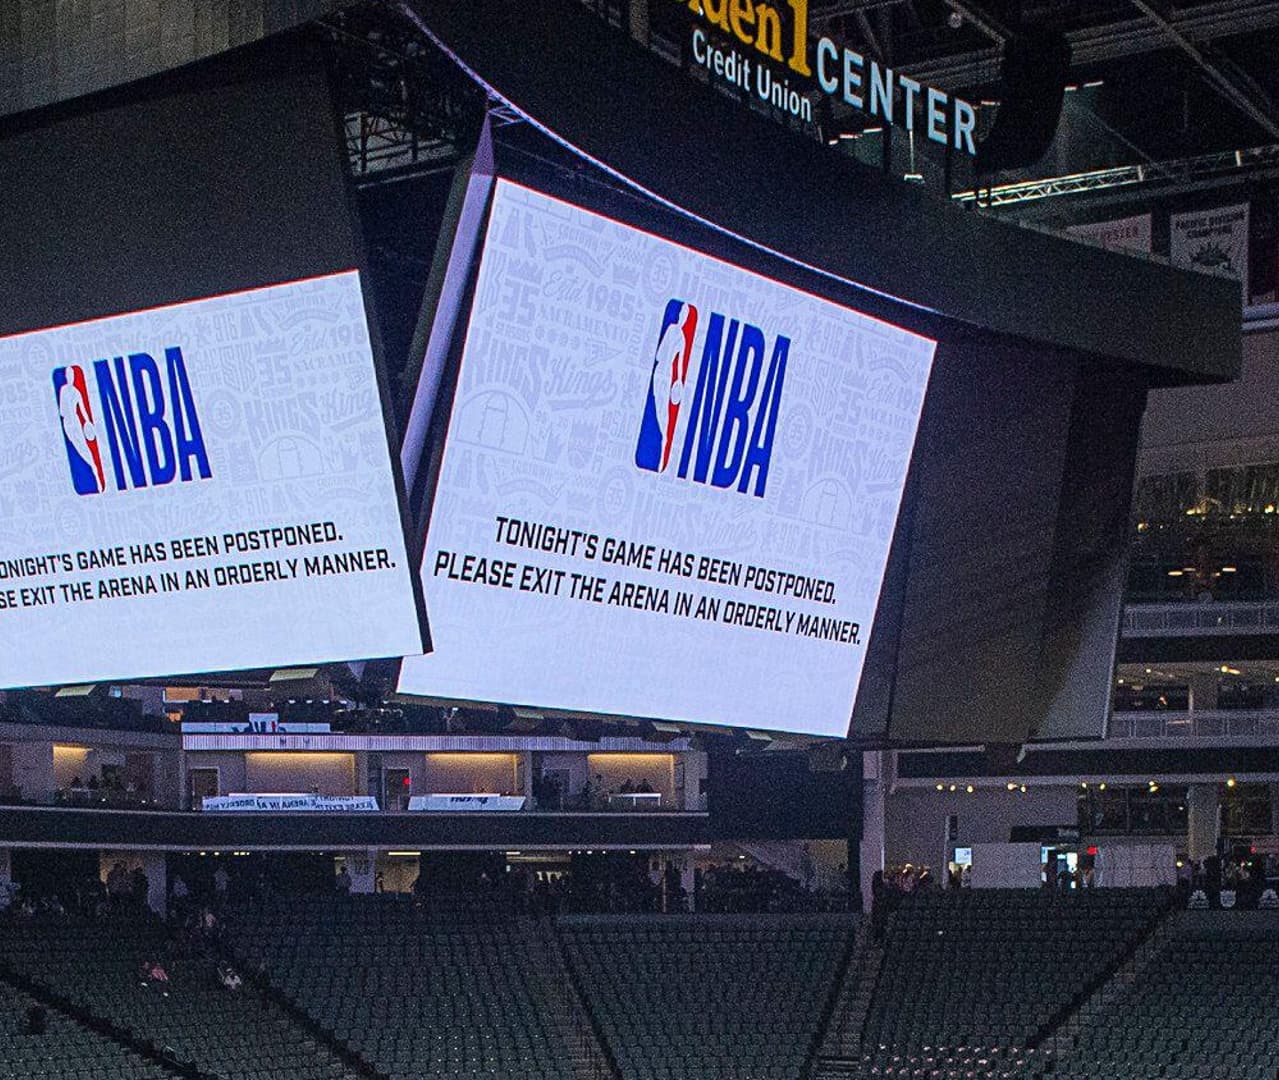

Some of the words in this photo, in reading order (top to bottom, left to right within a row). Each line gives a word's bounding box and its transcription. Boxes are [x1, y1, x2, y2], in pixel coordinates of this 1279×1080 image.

[687, 0, 812, 77] den1
[817, 37, 977, 156] CENTER
[692, 28, 750, 92] Credit
[756, 64, 813, 123] Union
[92, 347, 212, 491] NBA
[677, 311, 791, 498] NBA
[20, 585, 56, 607] EXIT
[60, 581, 94, 602] THE
[98, 575, 158, 599] ARENA
[161, 572, 179, 592] IN
[185, 569, 210, 589] AN
[214, 559, 298, 586] ORDERLY
[303, 549, 396, 576] MANNER.
[77, 547, 126, 570] GAME
[130, 543, 166, 564] HAS
[171, 536, 219, 560] BEEN
[224, 521, 344, 554] POSTPONED.
[496, 516, 598, 560] TONIGHT'S
[601, 538, 657, 572] GAME
[659, 549, 695, 577] HAS
[698, 557, 742, 588] BEEN
[744, 566, 837, 605] POSTPONED.
[433, 550, 517, 589] PLEASE
[519, 565, 567, 596] EXIT
[570, 574, 607, 604] THE
[608, 581, 669, 614] ARENA
[674, 592, 692, 618] IN
[694, 596, 720, 621] AN
[722, 600, 796, 635] ORDERLY
[796, 616, 862, 646] MANNER.
